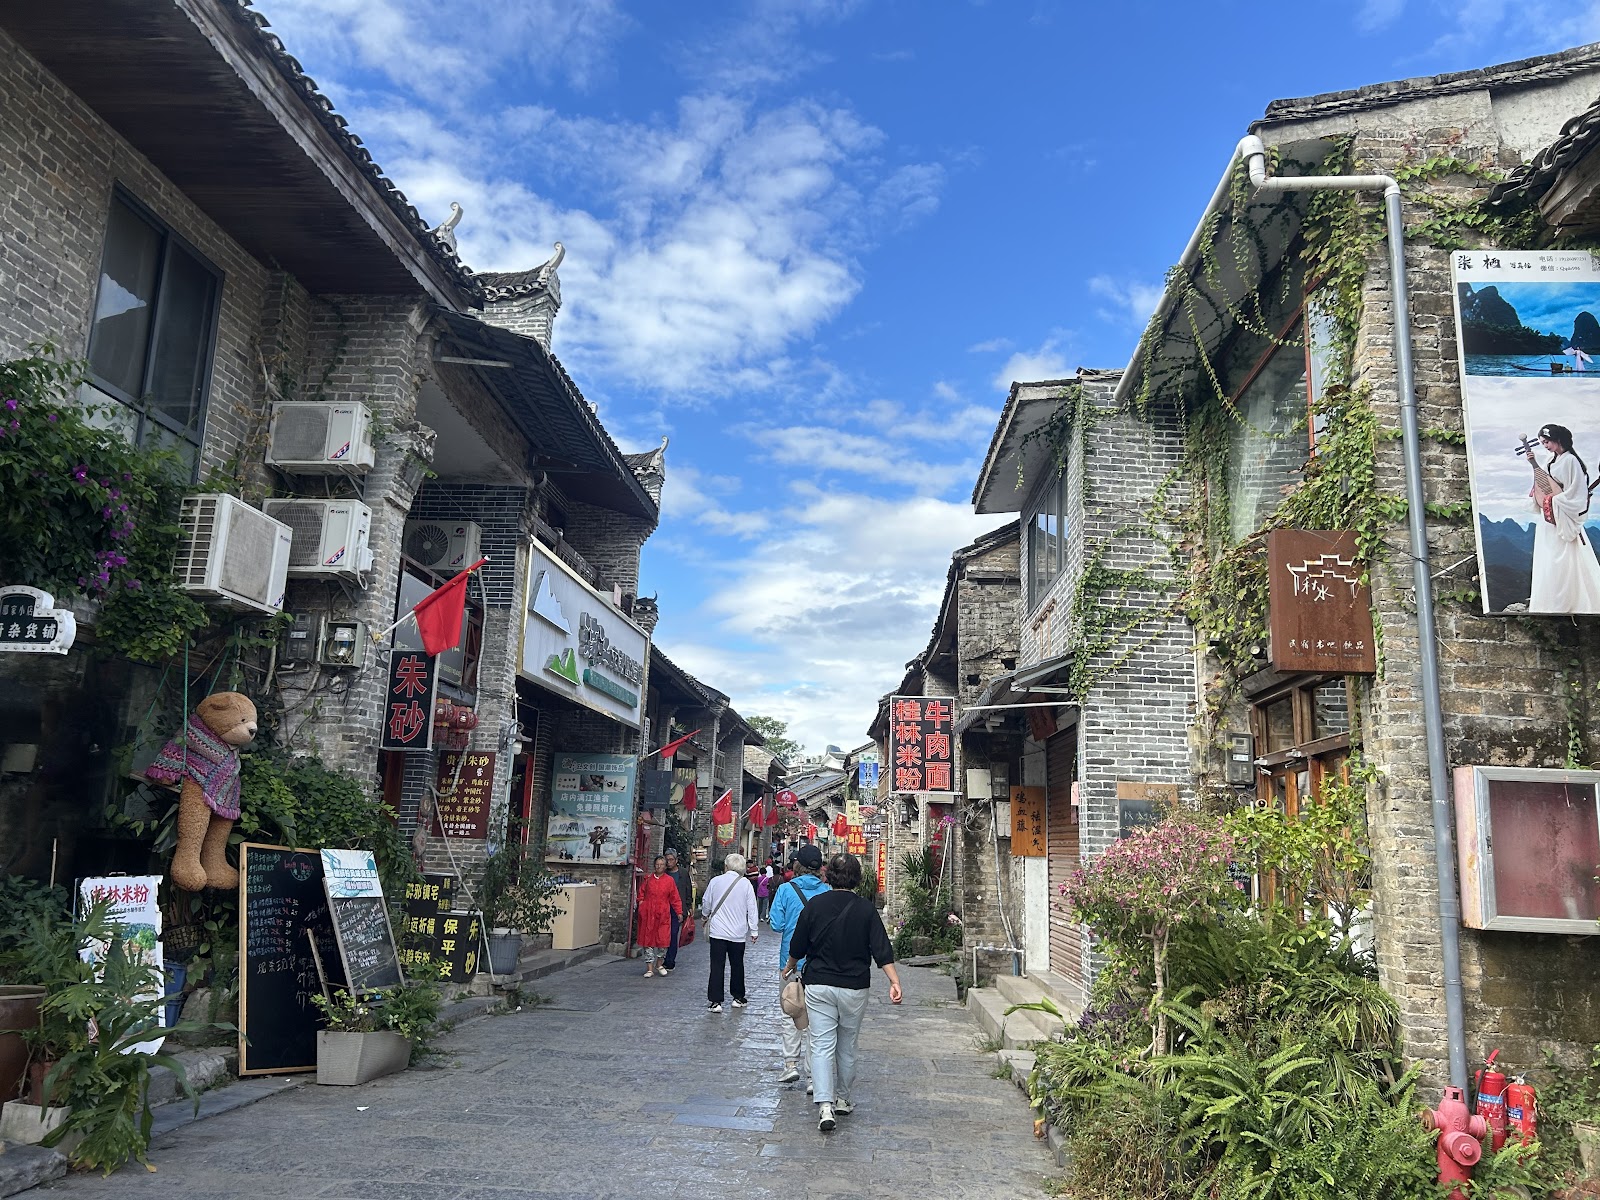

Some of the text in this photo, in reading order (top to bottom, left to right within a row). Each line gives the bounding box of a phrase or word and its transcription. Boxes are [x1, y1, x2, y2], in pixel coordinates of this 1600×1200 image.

[389, 655, 428, 743] 朱砂
[896, 700, 922, 790] 桂林米粉
[925, 700, 951, 791] 牛肉面
[561, 793, 610, 803] 店内漓江渔翁
[576, 803, 625, 813] 免费照相打卡
[1015, 791, 1028, 832] 鸡血藤
[405, 883, 440, 901] 辟邪镇宅
[440, 919, 459, 977] 保平安
[465, 919, 479, 975] 朱砂
